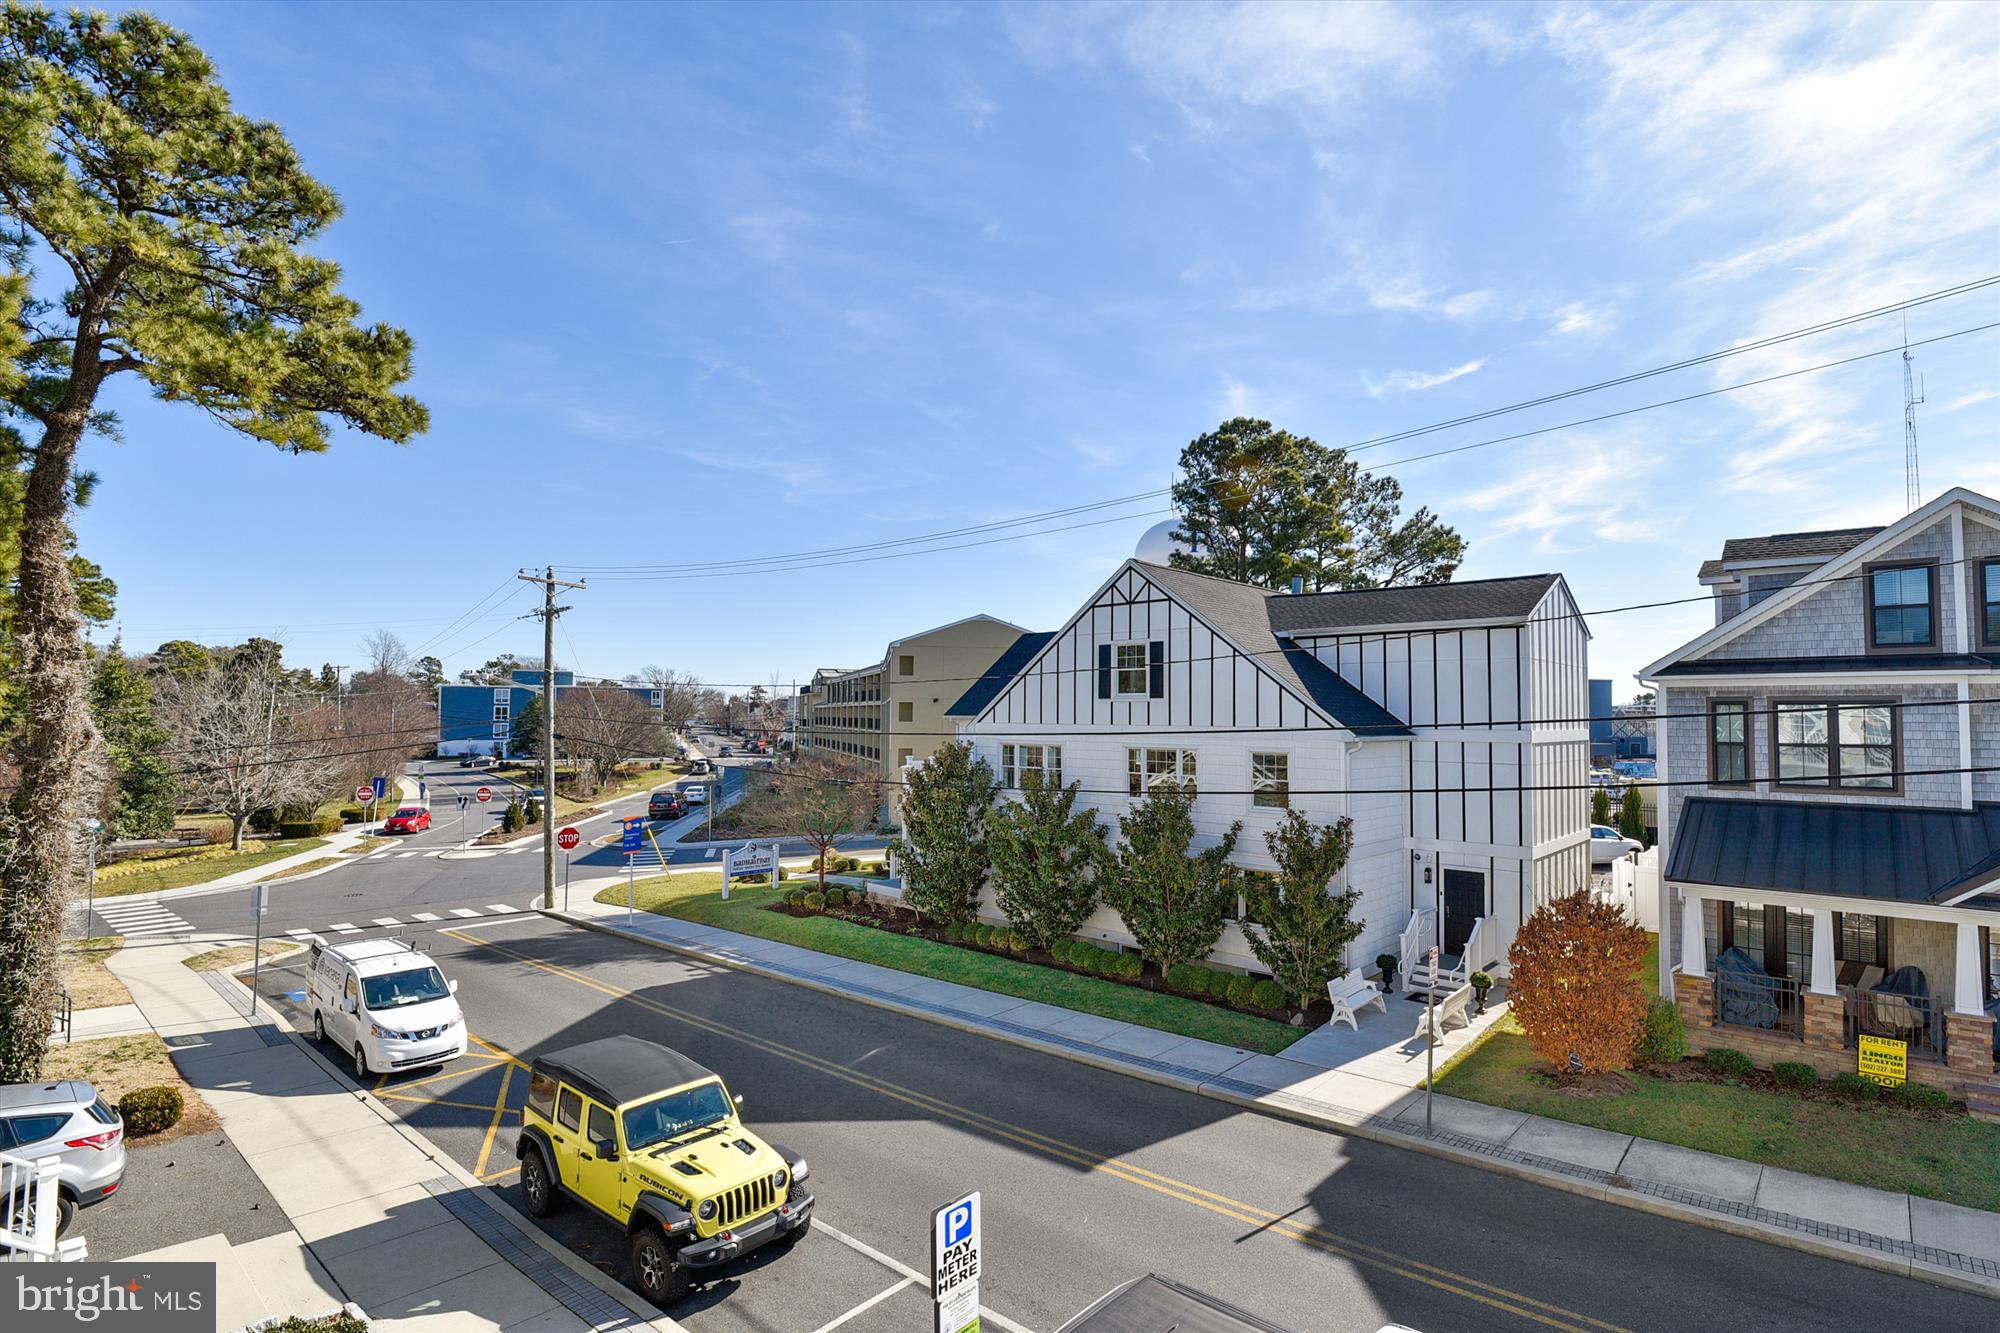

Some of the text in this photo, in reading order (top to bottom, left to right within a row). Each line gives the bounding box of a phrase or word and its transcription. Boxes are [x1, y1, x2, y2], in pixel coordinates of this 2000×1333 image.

[558, 833, 579, 844] STOP
[1860, 1036, 1905, 1048] FOR RENT
[1862, 1050, 1904, 1062] LINGO
[1862, 1056, 1904, 1068] REALTOR
[639, 1174, 683, 1201] RUBICON
[949, 1206, 969, 1245] P
[943, 1238, 973, 1265] PAY
[938, 1249, 977, 1282] METER
[938, 1262, 978, 1296] HERE
